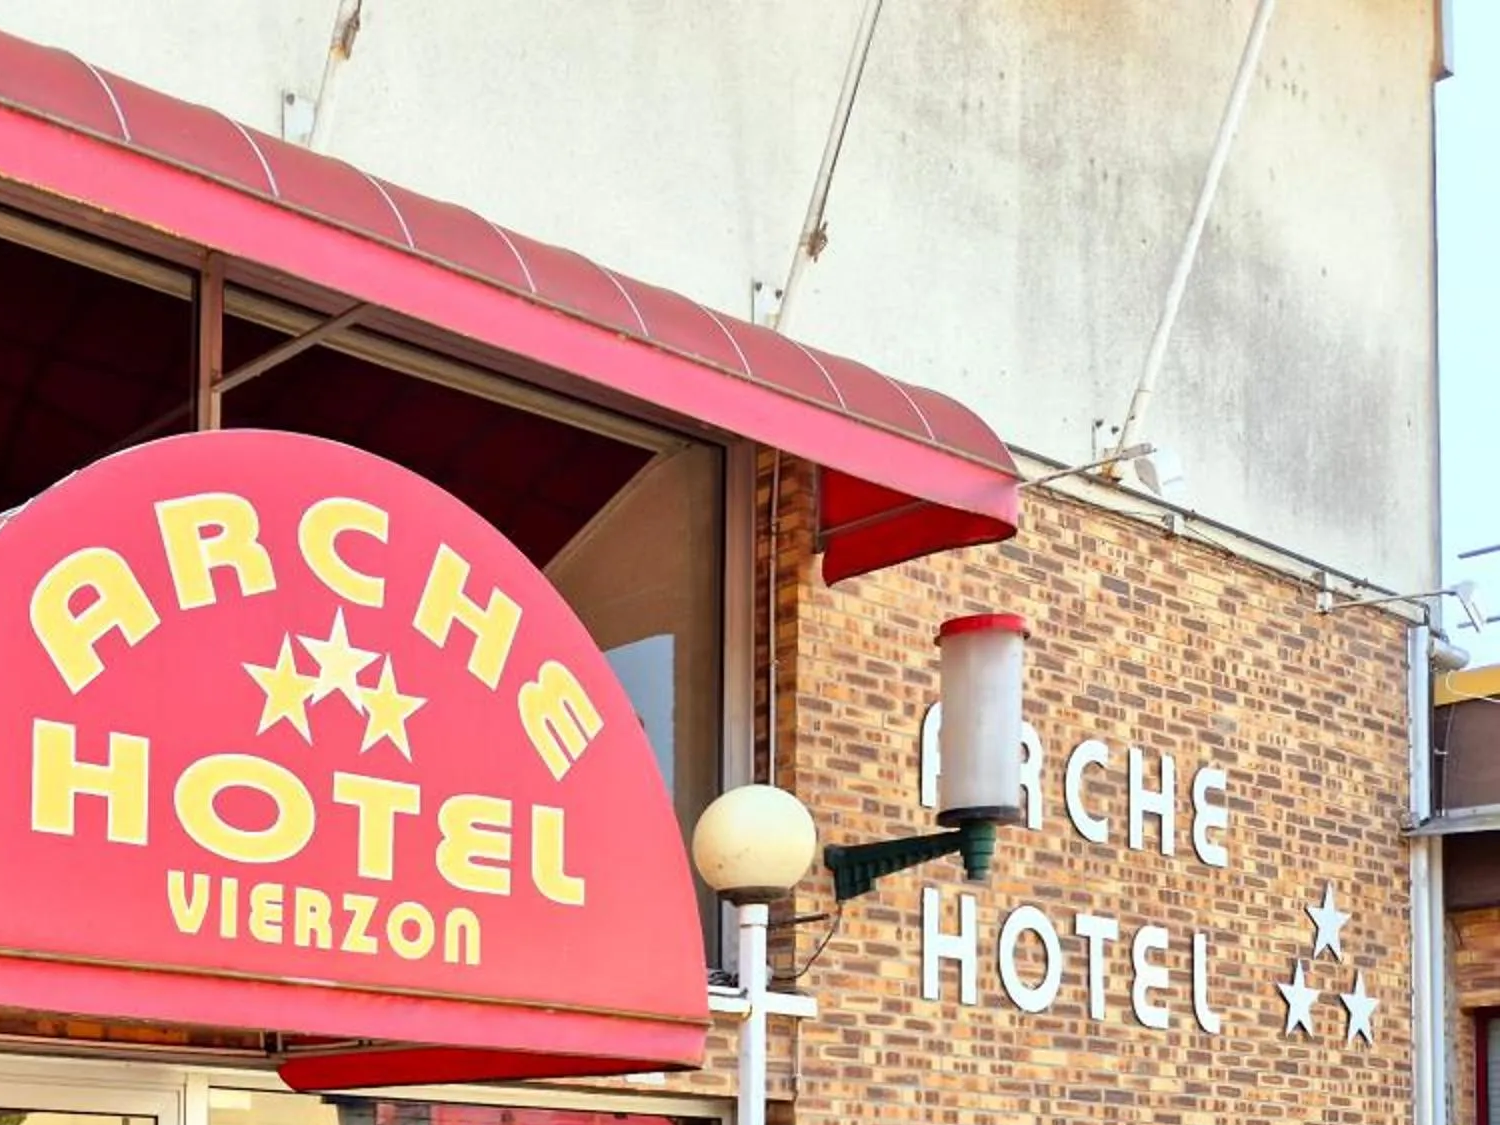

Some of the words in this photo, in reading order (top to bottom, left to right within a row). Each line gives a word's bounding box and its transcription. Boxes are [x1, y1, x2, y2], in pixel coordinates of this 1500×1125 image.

[29, 492, 604, 782] ARCHE
[31, 717, 586, 906] HOTEL
[167, 869, 481, 966] VIERZON
[921, 887, 1222, 1034] HOTEL
